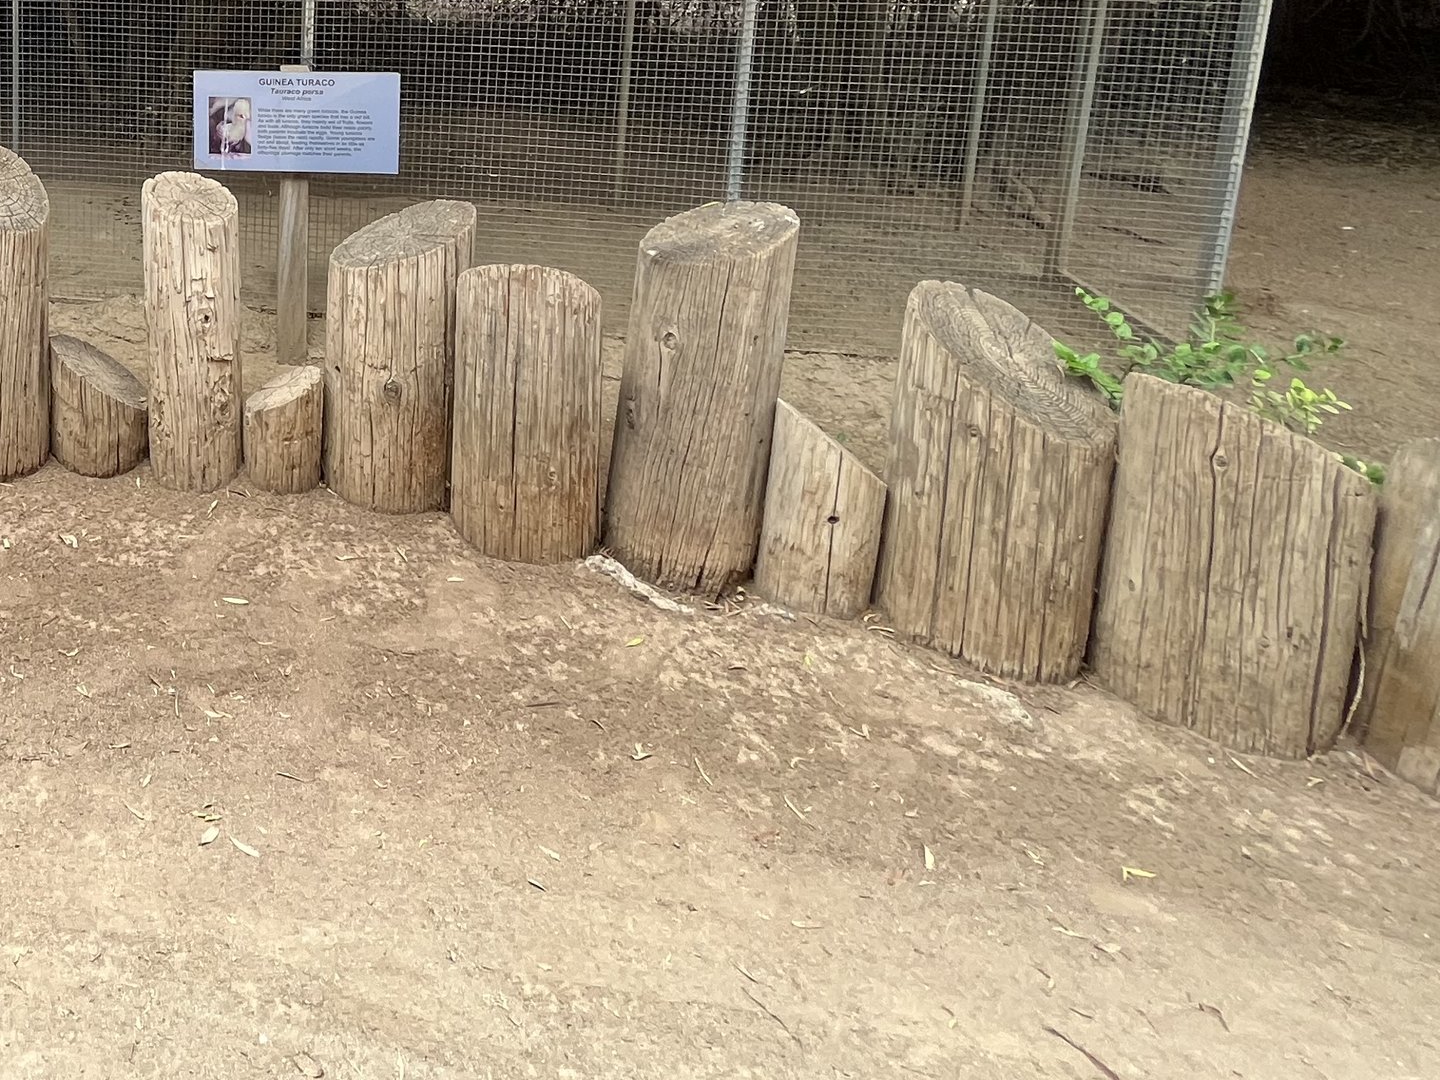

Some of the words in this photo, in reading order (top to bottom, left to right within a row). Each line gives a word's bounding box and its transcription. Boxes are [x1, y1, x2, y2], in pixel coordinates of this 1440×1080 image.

[258, 78, 294, 86] GUINEA
[296, 78, 336, 87] TURACO
[271, 87, 301, 95] Tauraco
